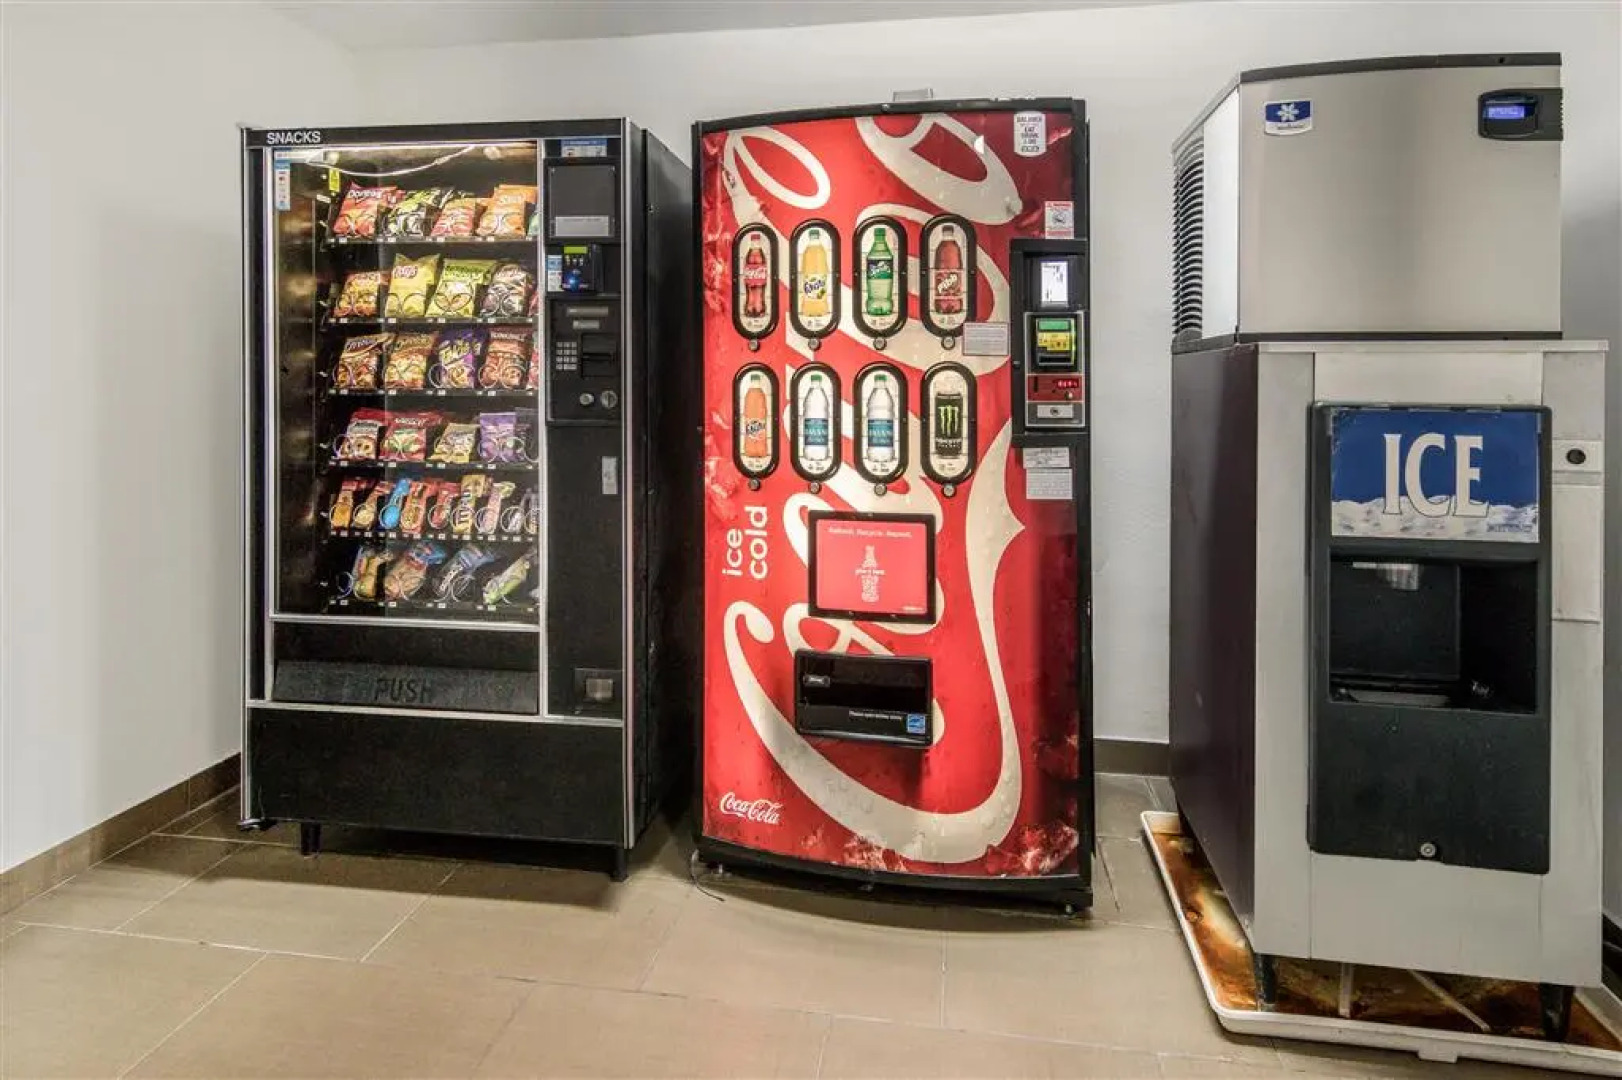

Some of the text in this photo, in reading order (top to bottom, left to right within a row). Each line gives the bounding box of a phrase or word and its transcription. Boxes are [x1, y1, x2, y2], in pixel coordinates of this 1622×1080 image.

[267, 131, 321, 144] SNACKS
[1383, 433, 1489, 518] ICE
[722, 528, 743, 576] ice
[744, 506, 768, 579] cold
[374, 677, 434, 703] PUSH
[720, 791, 783, 825] Coca-Cola
